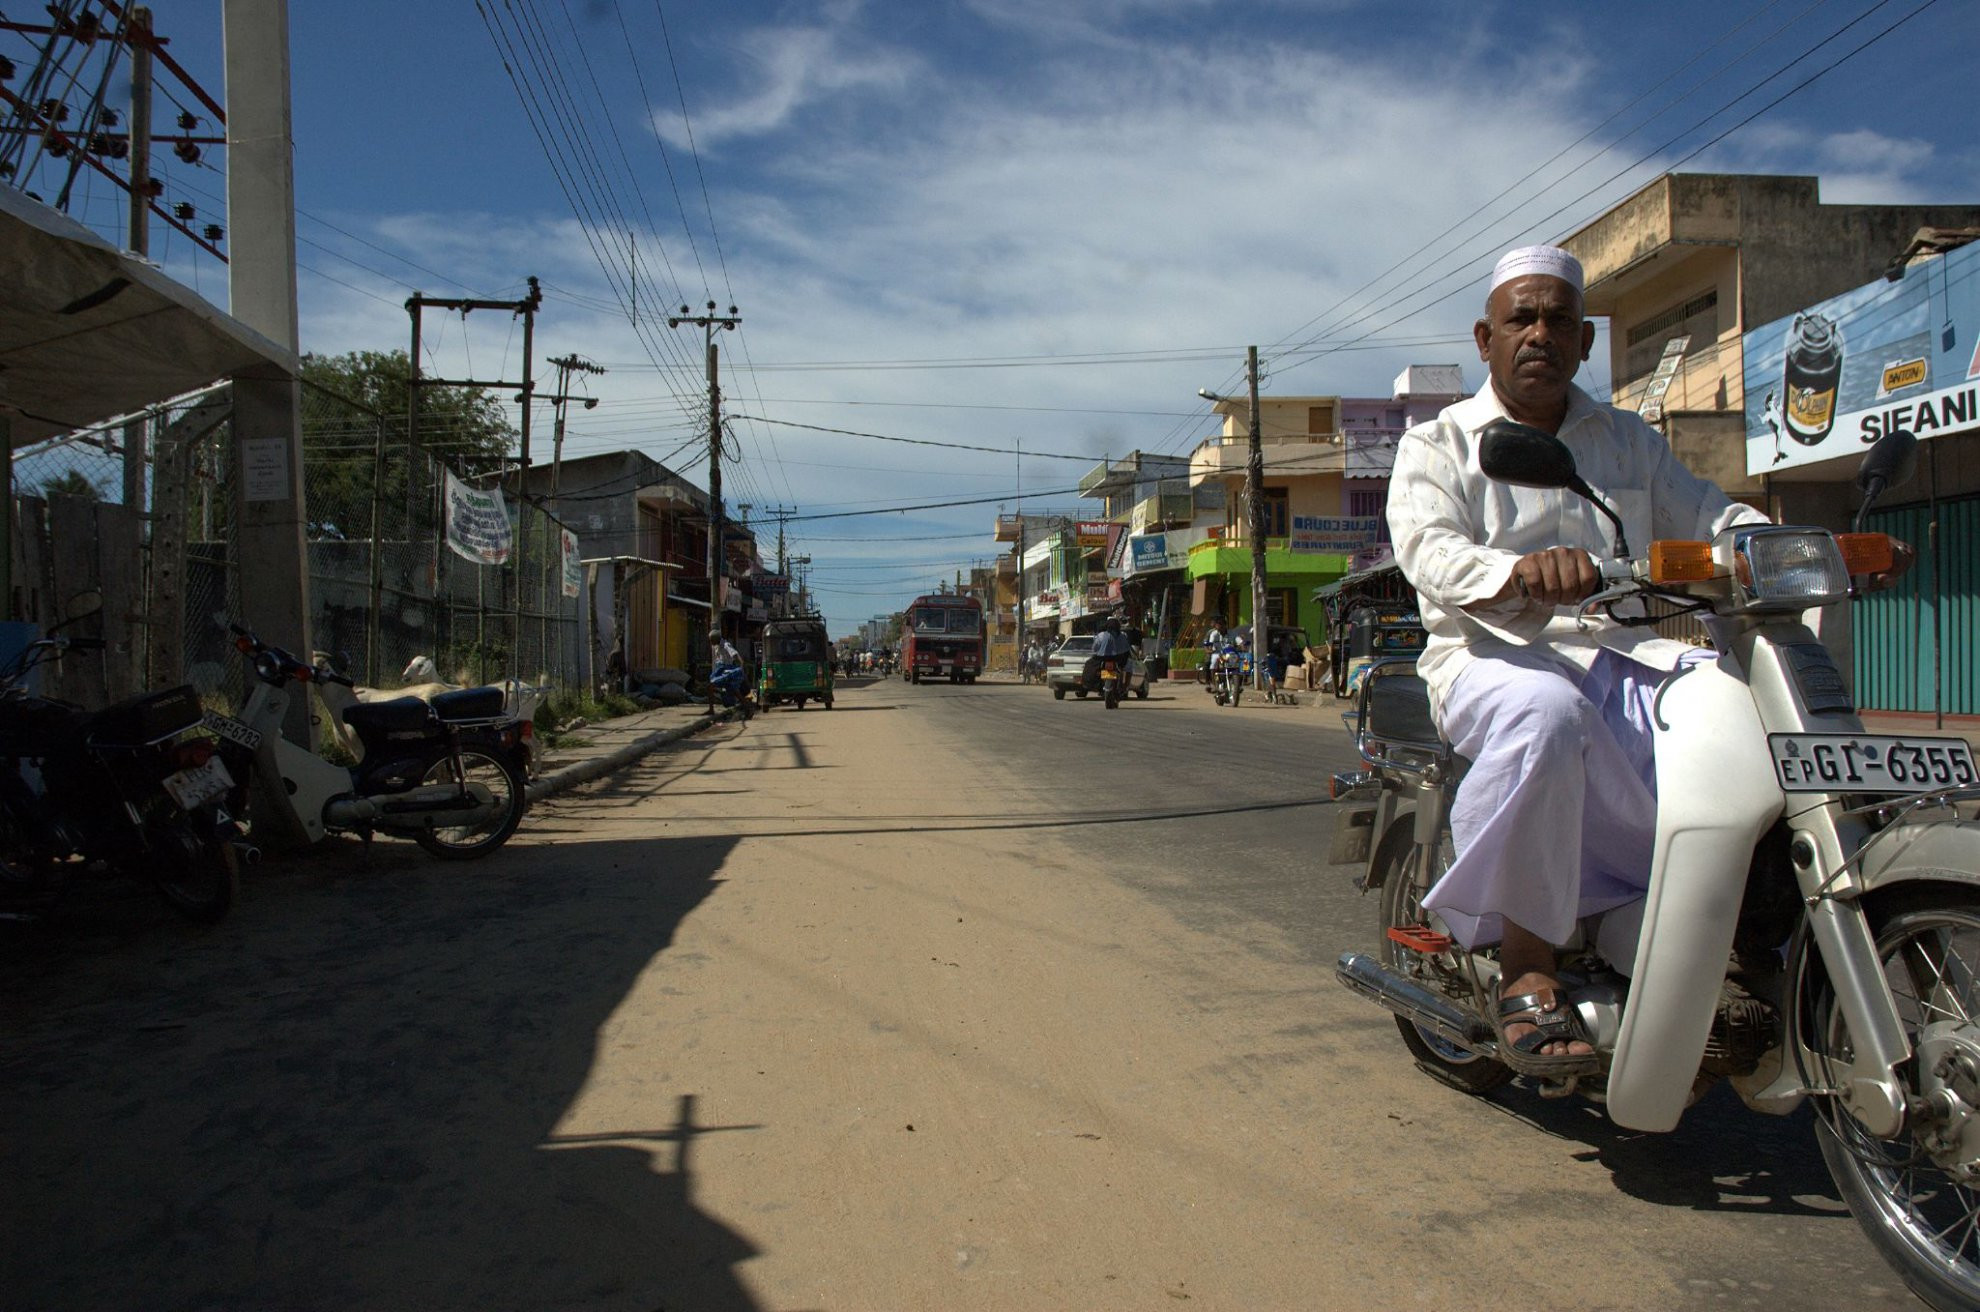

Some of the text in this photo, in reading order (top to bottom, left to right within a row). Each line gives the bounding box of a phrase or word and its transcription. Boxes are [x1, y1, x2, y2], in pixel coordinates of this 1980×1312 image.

[1887, 367, 1920, 385] ANTON
[1860, 388, 1977, 444] SIFANI
[1780, 759, 1813, 782] EP
